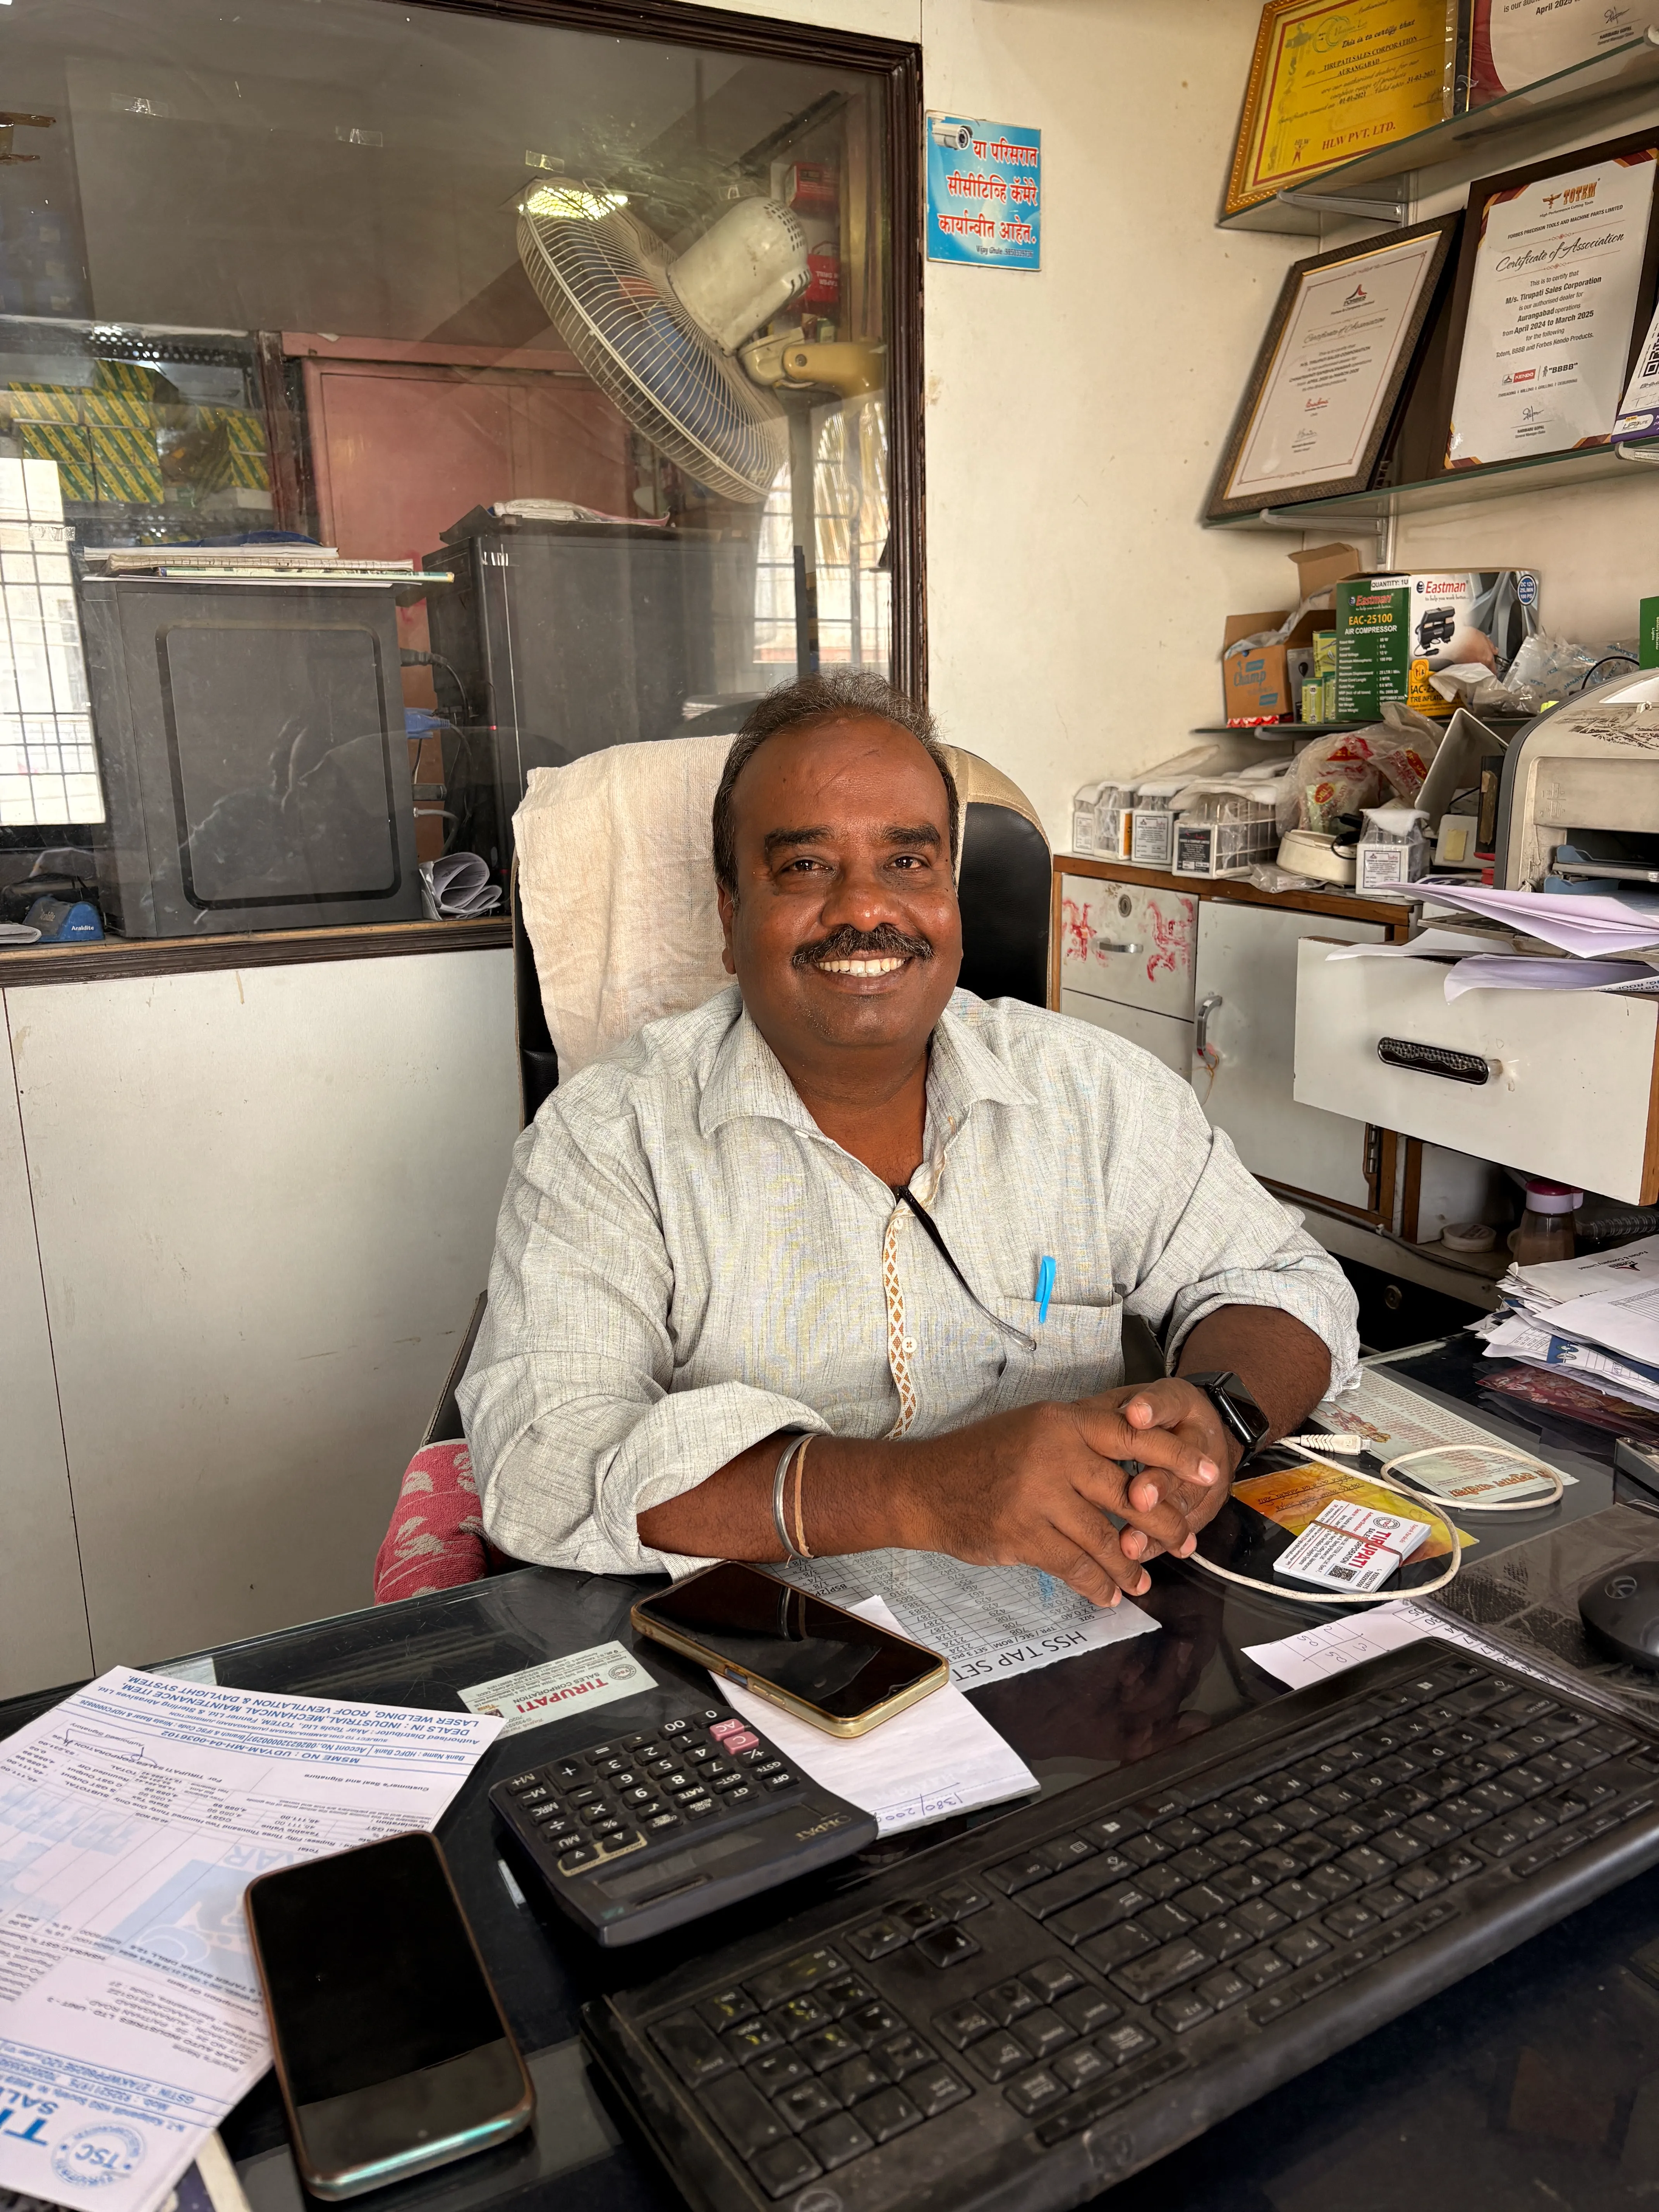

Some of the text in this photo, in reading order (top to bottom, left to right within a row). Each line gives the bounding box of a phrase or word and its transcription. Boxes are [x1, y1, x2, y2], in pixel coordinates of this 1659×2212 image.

[1536, 2, 1553, 15] April
[1322, 122, 1396, 151] HLW PVT. LTD.
[972, 137, 1038, 167] या परिसरात
[1563, 182, 1597, 205] TOTEM
[1524, 225, 1546, 235] PRECISION
[1570, 214, 1589, 223] MACHINE
[1605, 204, 1623, 214] LIMITED
[938, 210, 1036, 244] कार्यान्वीत आहेत.
[976, 246, 988, 255] Vijay
[1496, 233, 1624, 272] Certificate of Association
[1552, 273, 1568, 283] certify
[1520, 289, 1544, 303] Tirupati
[1545, 285, 1562, 295] Sales
[1563, 276, 1602, 291] Corporation
[1533, 297, 1558, 308] authorised
[1559, 294, 1575, 302] dealer
[1517, 303, 1581, 323] Aurangabad operations
[1514, 324, 1529, 334] April
[1530, 320, 1546, 330] 2024
[1555, 314, 1576, 326] March
[1577, 310, 1594, 320] 2025
[1542, 327, 1565, 339] following
[1536, 339, 1553, 349] Forbes
[1553, 337, 1570, 346] Kendo
[1570, 332, 1594, 343] Products.
[1515, 371, 1534, 381] KENDO
[1356, 581, 1466, 606] Eastman Eastman
[1349, 613, 1393, 625] EAC-25100
[1355, 625, 1397, 634] COMPRESSOR
[1340, 1540, 1364, 1563] ORPORATION
[883, 1566, 959, 1591] 1042 3126
[890, 1587, 912, 1597] 2010
[896, 1594, 918, 1603] 1665
[909, 1590, 984, 1615] 461 1383
[930, 1624, 952, 1634] 1287
[942, 1604, 1069, 1647] 0.45 708 2124
[949, 1609, 1081, 1654] 0.40 708 2124
[1041, 1625, 1057, 1635] TPR
[993, 1638, 1013, 1649] BOM
[1019, 1633, 1034, 1642] SEC
[951, 1631, 1087, 1681] HSS TAP SET
[974, 1646, 988, 1654] SET
[122, 1683, 149, 1695] ITEM,
[129, 1676, 178, 1693] SYSTEM.
[513, 1672, 600, 1704] SALES CORPORATION
[116, 1691, 160, 1705] Abrasives
[152, 1692, 242, 1712] MAINTENANCE
[178, 1688, 240, 1703] DAYLIGHT
[516, 1678, 608, 1713] TIRUPATI
[161, 1702, 196, 1712] Sterling
[252, 1699, 331, 1714] VENTILATION
[333, 1709, 371, 1718] ROOF
[134, 1714, 153, 1723] Bazar
[226, 1714, 258, 1723] Fenner
[261, 1718, 294, 1728] TOTEM,
[374, 1710, 433, 1723] WELDING,
[436, 1717, 479, 1727] LASER
[375, 1730, 426, 1740] Distributor
[426, 1726, 470, 1736] DEALS
[665, 1720, 746, 1744] 00 AC C
[427, 1735, 480, 1745] Authorised
[335, 1745, 367, 1753] Accont
[321, 1755, 360, 1763] MSME
[93, 1769, 129, 1782] Rounded
[110, 1765, 137, 1776] TOTAL
[756, 1761, 789, 1784] GST+ OFF
[65, 1781, 109, 1798] SUBTOTAL
[531, 1786, 748, 1816] MRC RATE GT
[75, 2145, 120, 2169] TSC
